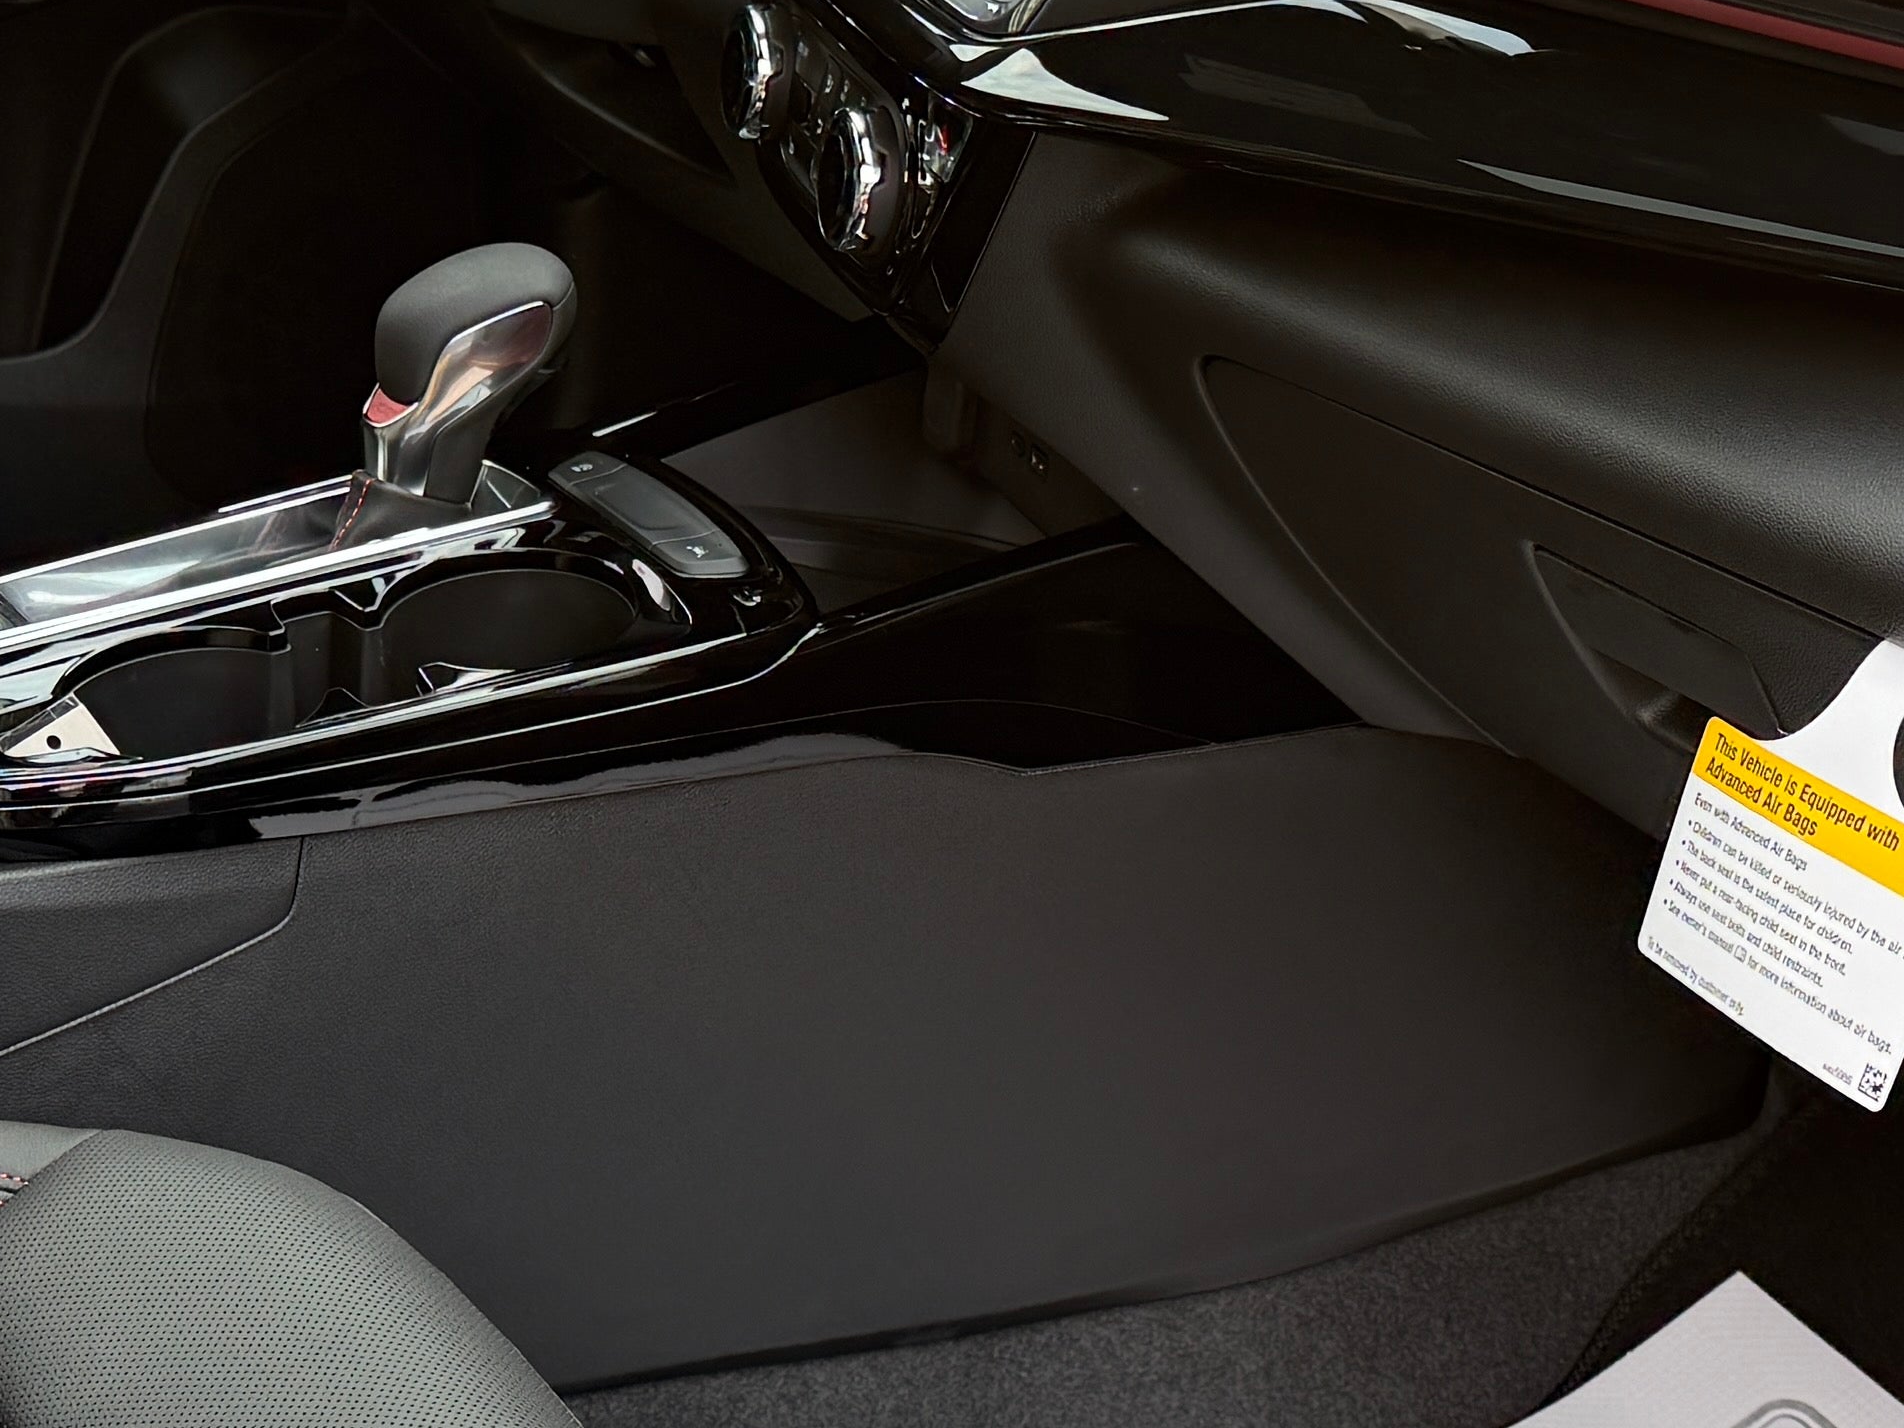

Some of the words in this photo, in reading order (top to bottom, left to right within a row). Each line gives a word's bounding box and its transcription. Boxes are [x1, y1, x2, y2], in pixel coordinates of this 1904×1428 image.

[1694, 792, 1712, 813] Even
[1714, 807, 1730, 824] with
[1730, 816, 1771, 850] Advanced
[1770, 841, 1784, 857] Air
[1784, 849, 1808, 872] Bags
[1705, 756, 1763, 804] Advanced
[1762, 792, 1783, 816] Air
[1783, 803, 1818, 837] Bags
[1714, 732, 1738, 761] This
[1740, 747, 1783, 788] Vehicle
[1784, 774, 1797, 796] is
[1799, 783, 1867, 833] Equipped
[1867, 822, 1900, 852] with
[1673, 881, 1698, 906] Always
[1698, 899, 1712, 915] use
[1711, 907, 1727, 925] seat
[1746, 931, 1763, 949] and
[1762, 941, 1783, 963] child
[1680, 860, 1700, 882] Never
[1699, 876, 1713, 892] put
[1718, 888, 1759, 924] rear-facing
[1759, 913, 1780, 934] child
[1779, 928, 1798, 946] seat
[1798, 938, 1808, 953] in
[1808, 943, 1823, 961] the
[1687, 840, 1699, 858] The
[1699, 851, 1717, 869] back
[1717, 863, 1735, 881] seat
[1741, 877, 1754, 894] the
[1755, 886, 1779, 910] safest
[1778, 902, 1802, 924] place
[1802, 915, 1817, 931] for
[1692, 821, 1723, 848] Children
[1722, 842, 1736, 859] can
[1749, 855, 1772, 881] killed
[1783, 880, 1824, 913] seriously
[1823, 901, 1856, 930] injured
[1856, 921, 1870, 940] by
[1870, 929, 1887, 948] the
[1888, 940, 1902, 956] air
[1668, 900, 1681, 918] See
[1747, 955, 1759, 970] for
[1758, 966, 1780, 985] more
[1780, 974, 1827, 1015] information
[1827, 1008, 1854, 1031] about
[1853, 1023, 1868, 1039] air
[1867, 1030, 1892, 1055] bags.
